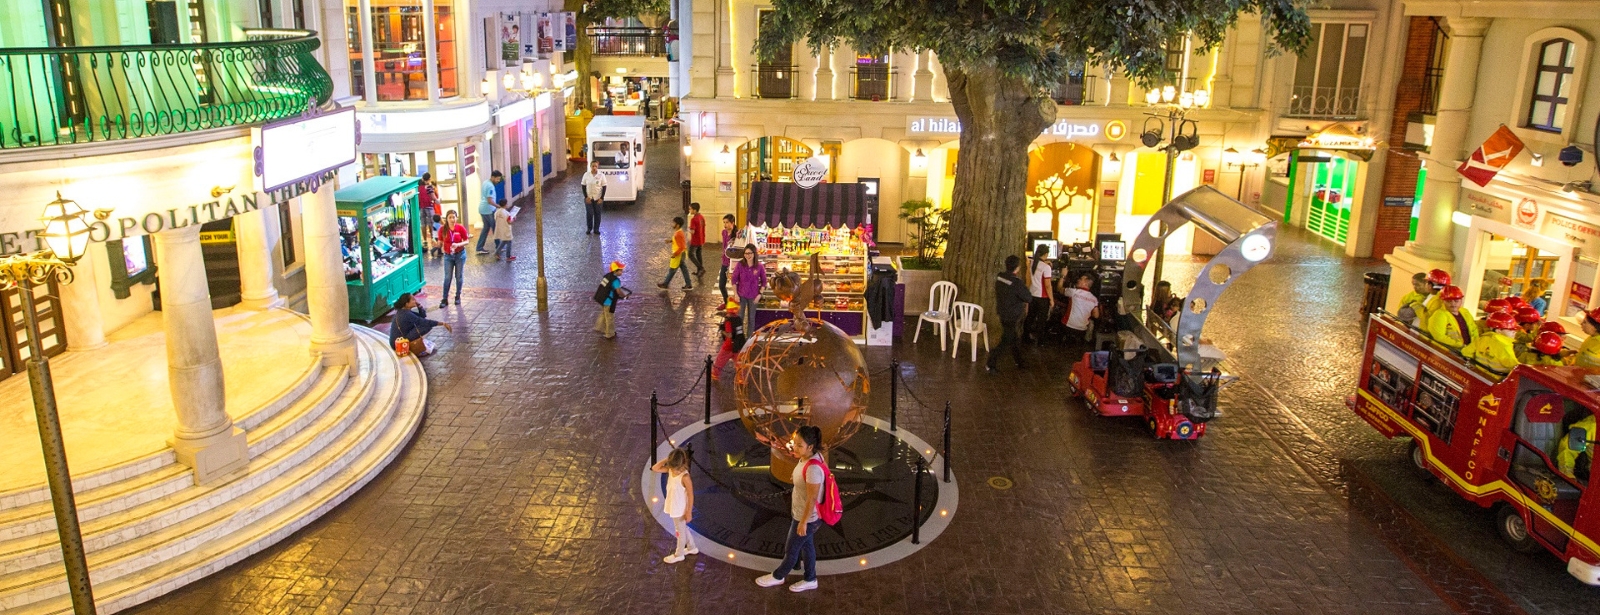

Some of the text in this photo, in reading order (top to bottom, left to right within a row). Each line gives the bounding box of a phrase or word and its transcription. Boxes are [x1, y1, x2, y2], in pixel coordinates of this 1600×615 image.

[911, 118, 925, 132] al
[0, 191, 260, 257] ETOPOLITAN
[1552, 217, 1577, 231] POLICE
[1465, 416, 1487, 480] NAFFCO
